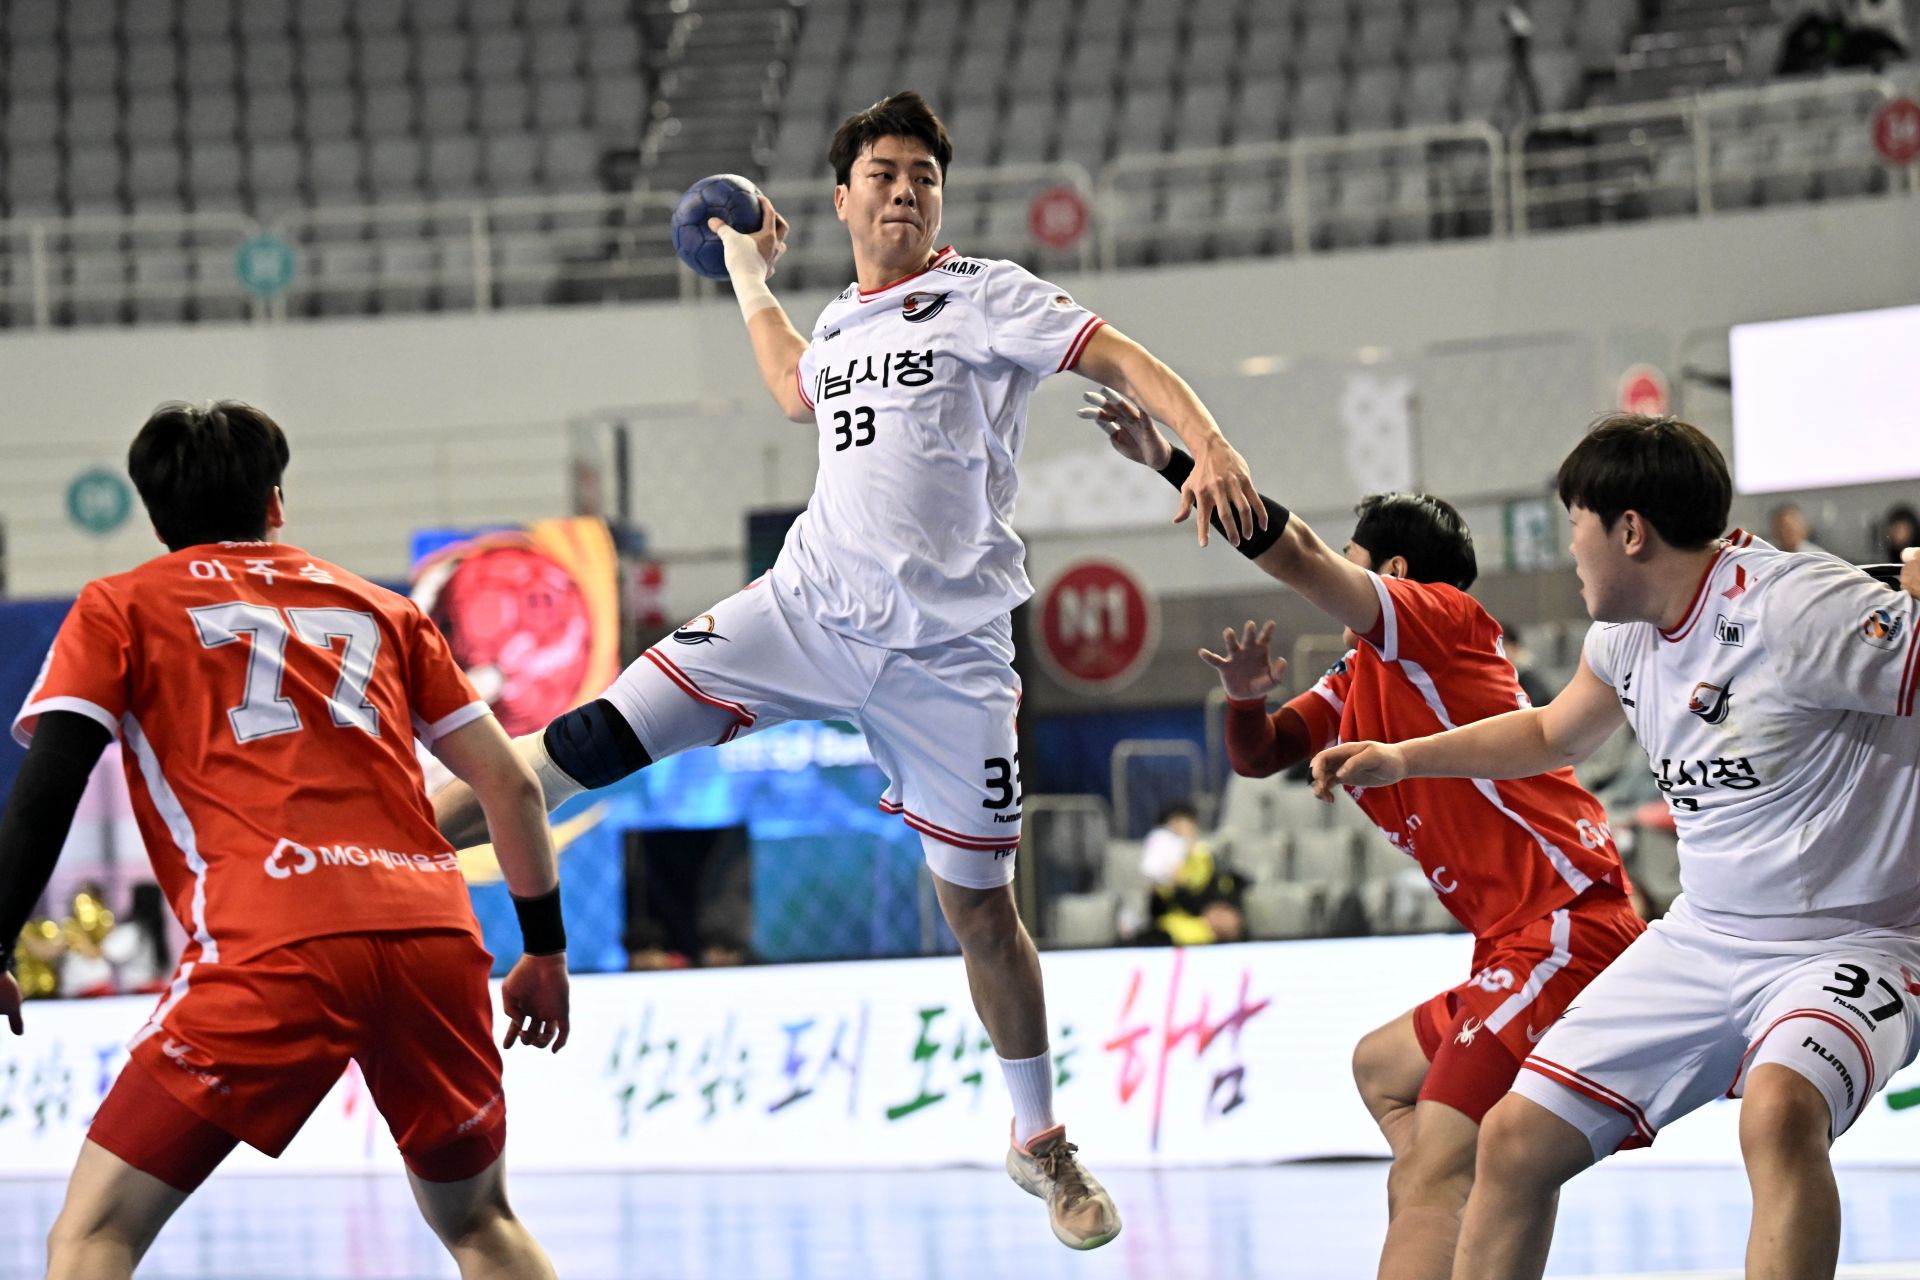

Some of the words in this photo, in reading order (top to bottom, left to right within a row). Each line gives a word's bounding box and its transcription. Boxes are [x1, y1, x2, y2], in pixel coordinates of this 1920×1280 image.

[833, 405, 876, 452] 33
[1058, 583, 1127, 642] N1
[186, 601, 381, 745] 77
[1822, 963, 1904, 1022] 37
[1833, 996, 1877, 1033] hummel
[768, 1000, 872, 1116] 도시
[1105, 948, 1270, 1151] 하남
[1802, 1036, 1855, 1111] hummel
